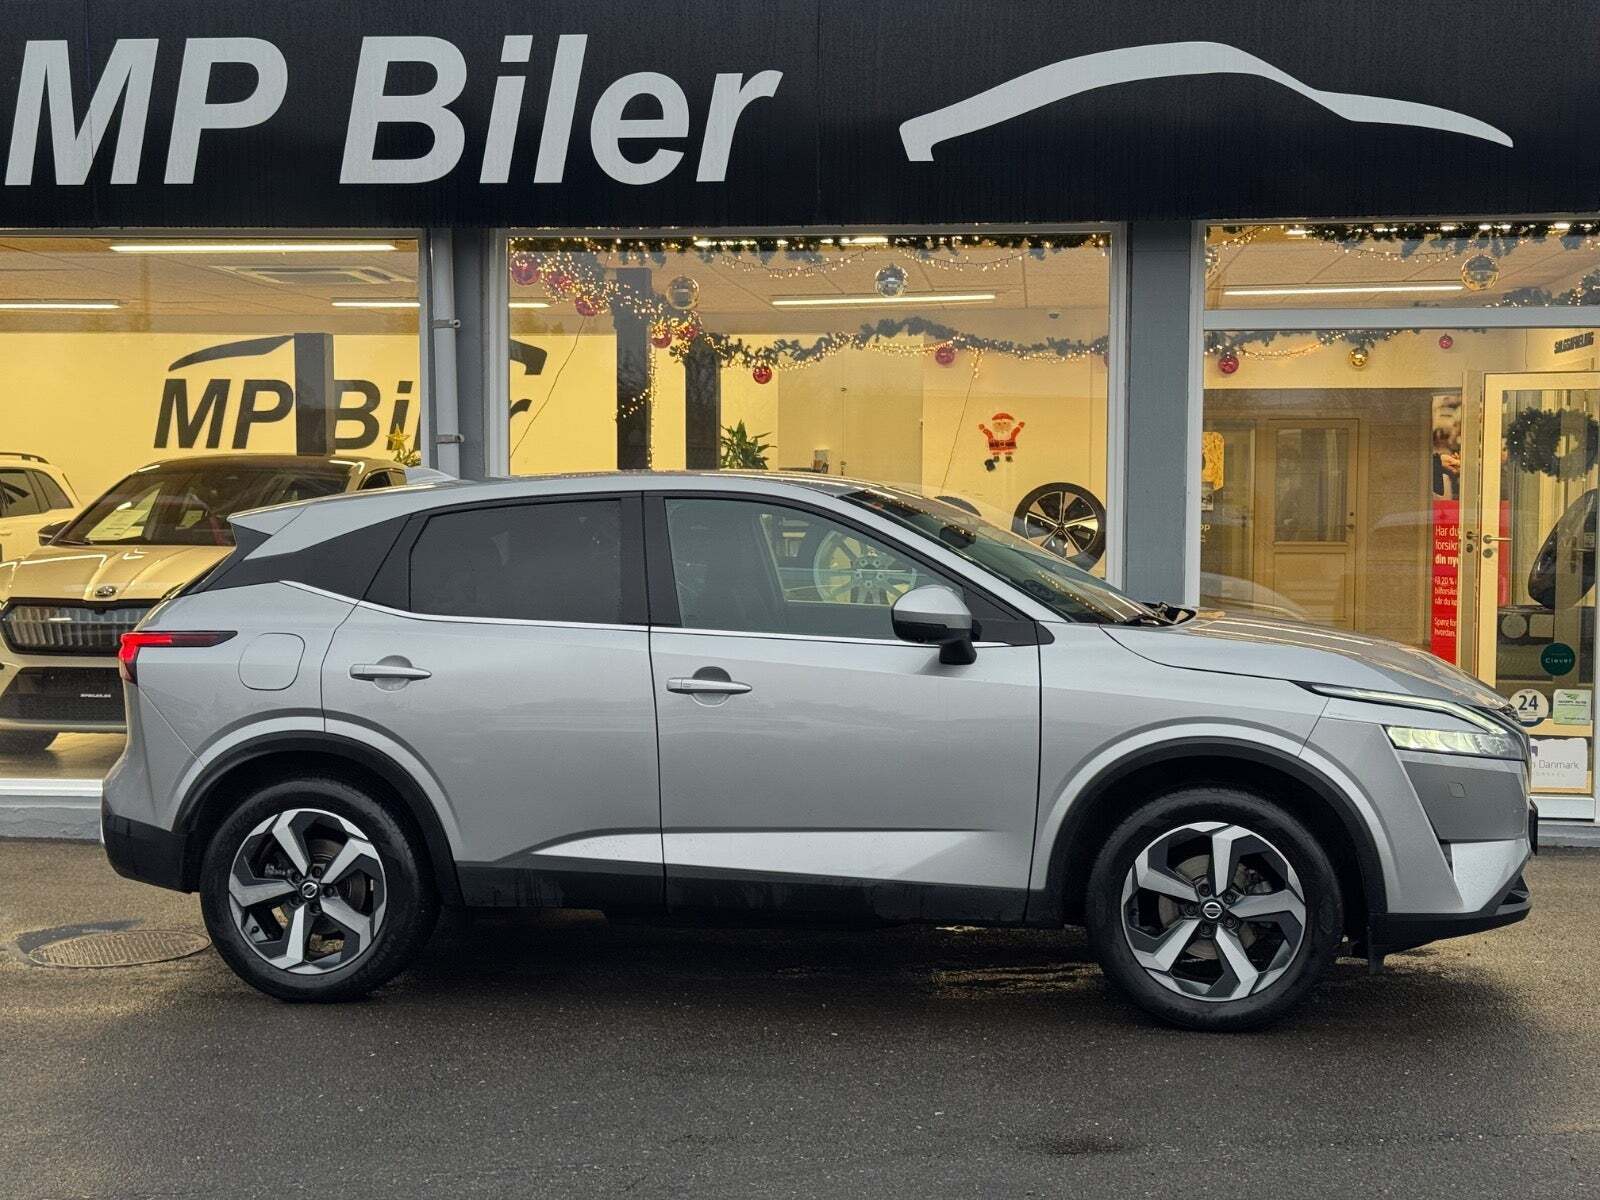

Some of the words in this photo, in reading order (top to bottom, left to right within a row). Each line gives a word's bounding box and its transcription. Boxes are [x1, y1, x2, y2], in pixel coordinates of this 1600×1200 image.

[5, 37, 288, 186] MP
[340, 34, 783, 185] Biler
[154, 378, 294, 449] MP
[1435, 525, 1448, 537] Har
[1435, 554, 1446, 565] din
[1518, 695, 1538, 711] 24
